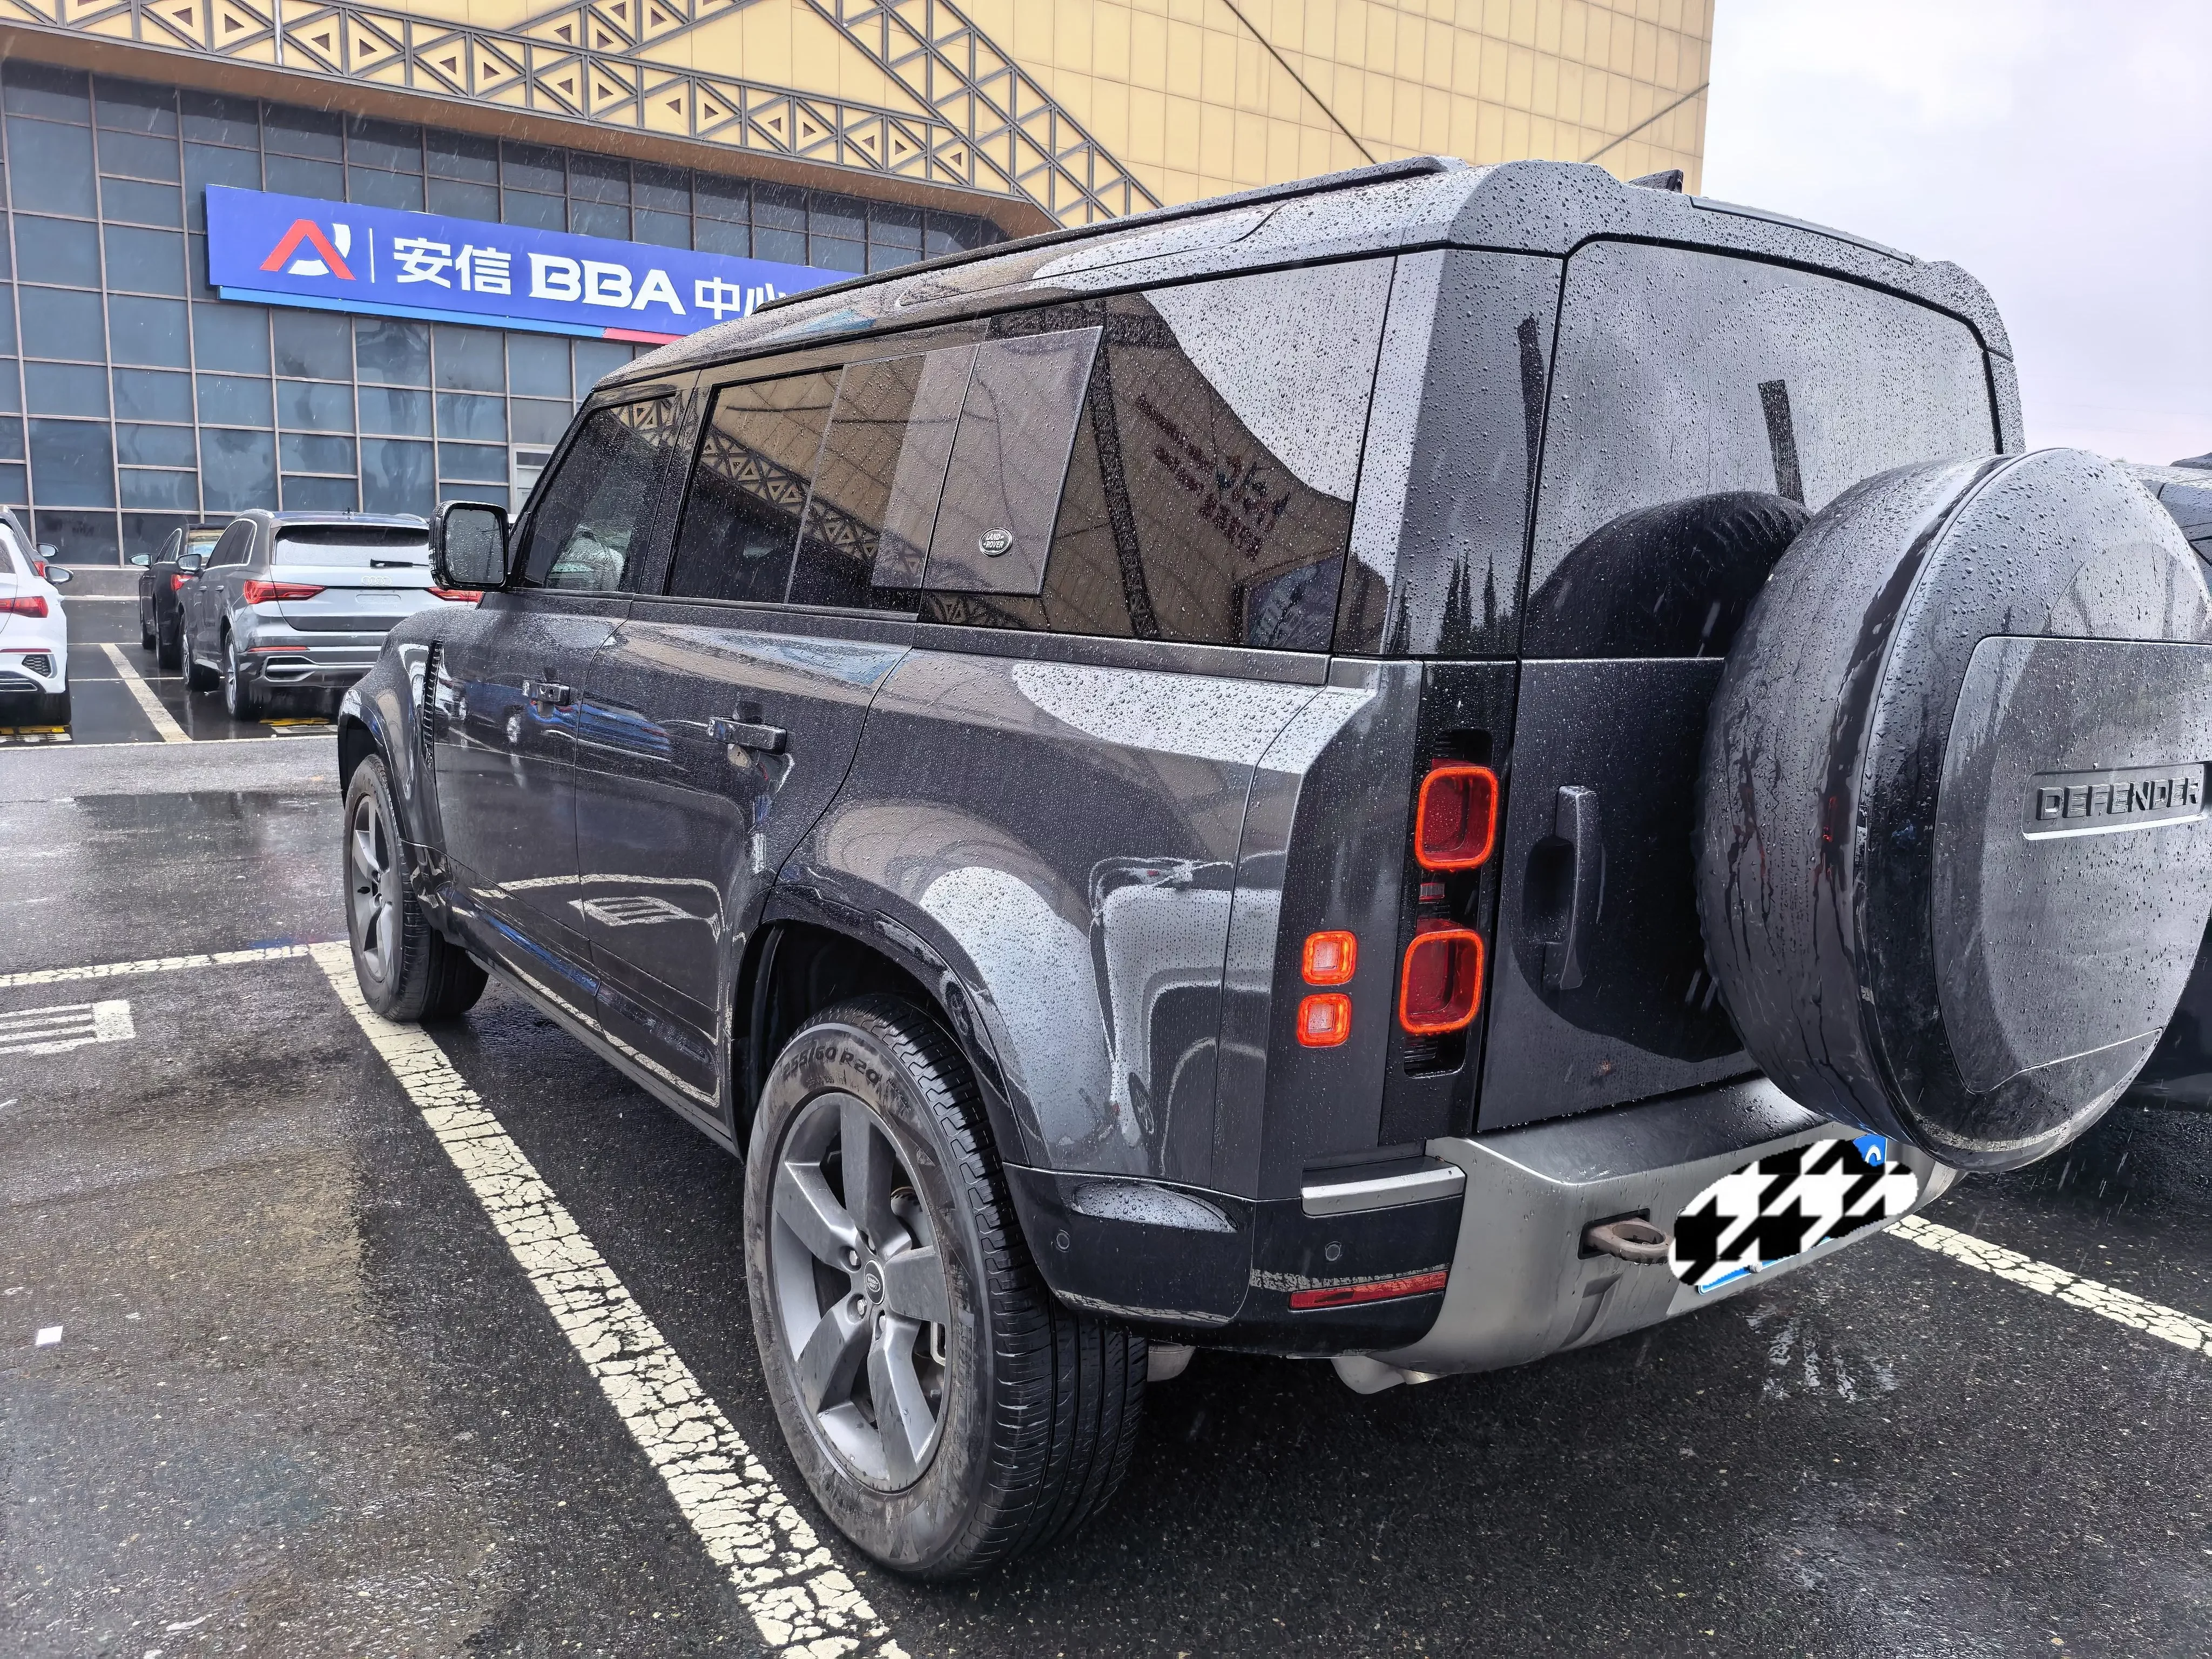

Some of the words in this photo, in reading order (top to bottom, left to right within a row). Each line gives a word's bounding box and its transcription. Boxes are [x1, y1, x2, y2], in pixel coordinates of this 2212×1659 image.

[394, 237, 511, 295] 安信
[527, 252, 686, 315] BBA
[2035, 775, 2201, 821] DEFENDER
